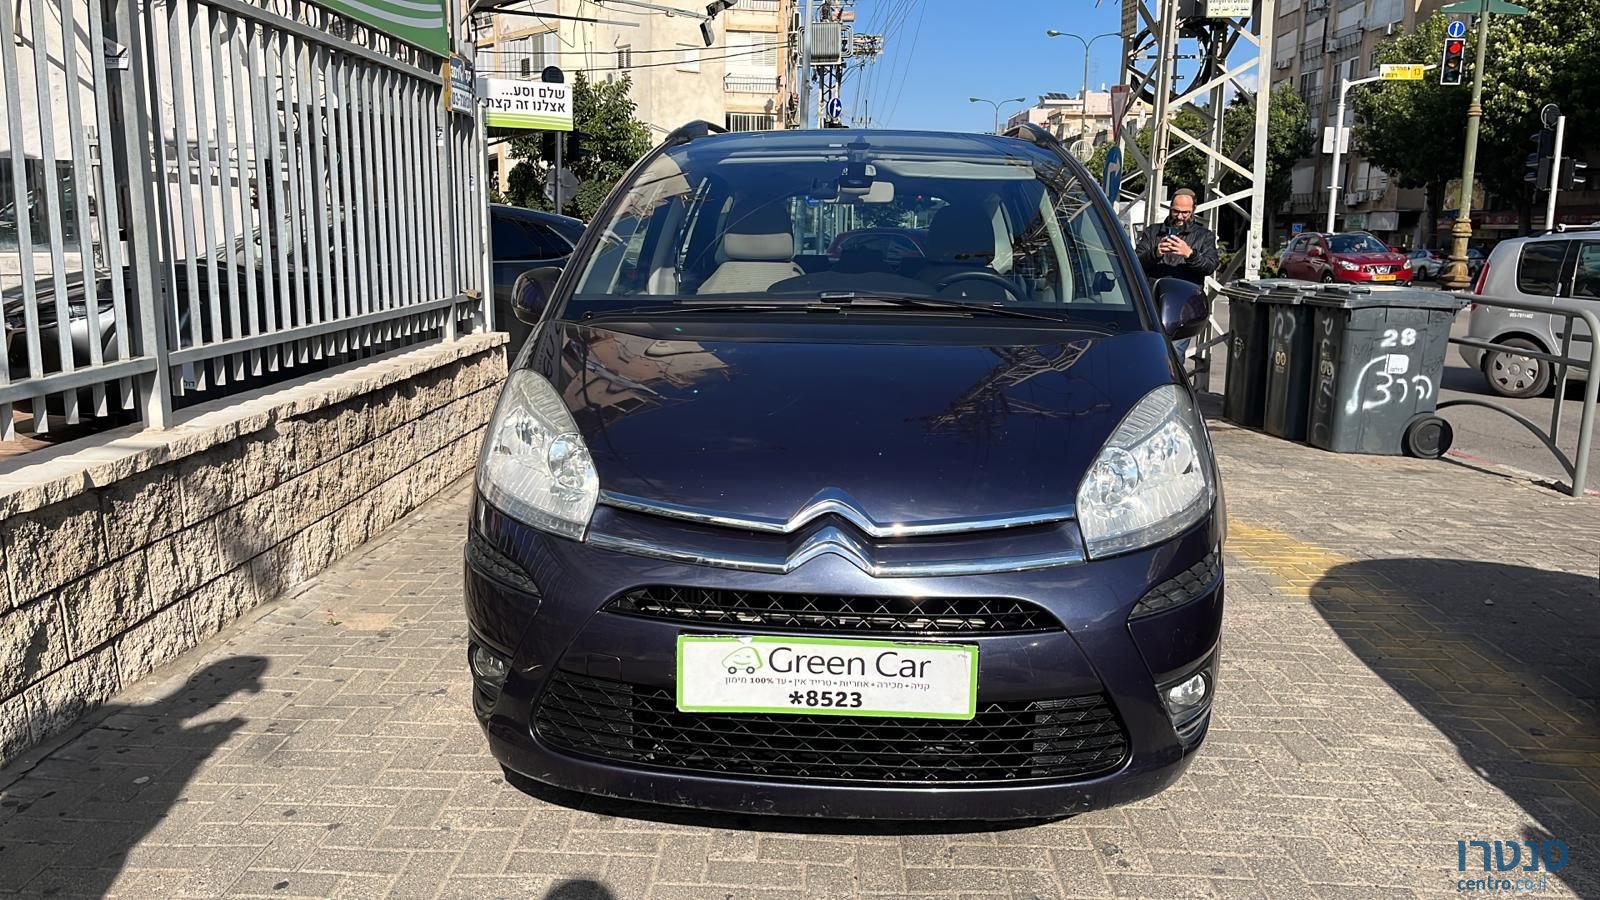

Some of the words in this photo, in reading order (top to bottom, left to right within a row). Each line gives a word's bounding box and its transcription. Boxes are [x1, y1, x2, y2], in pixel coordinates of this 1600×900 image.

[501, 86, 534, 97] וסע...
[539, 86, 565, 99] שלם
[486, 97, 511, 111] קצת
[516, 100, 529, 110] זה
[533, 99, 566, 112] אצלנו
[1381, 327, 1417, 347] 28
[768, 646, 866, 676] Green
[875, 651, 932, 679] Car
[750, 677, 774, 685] 100%
